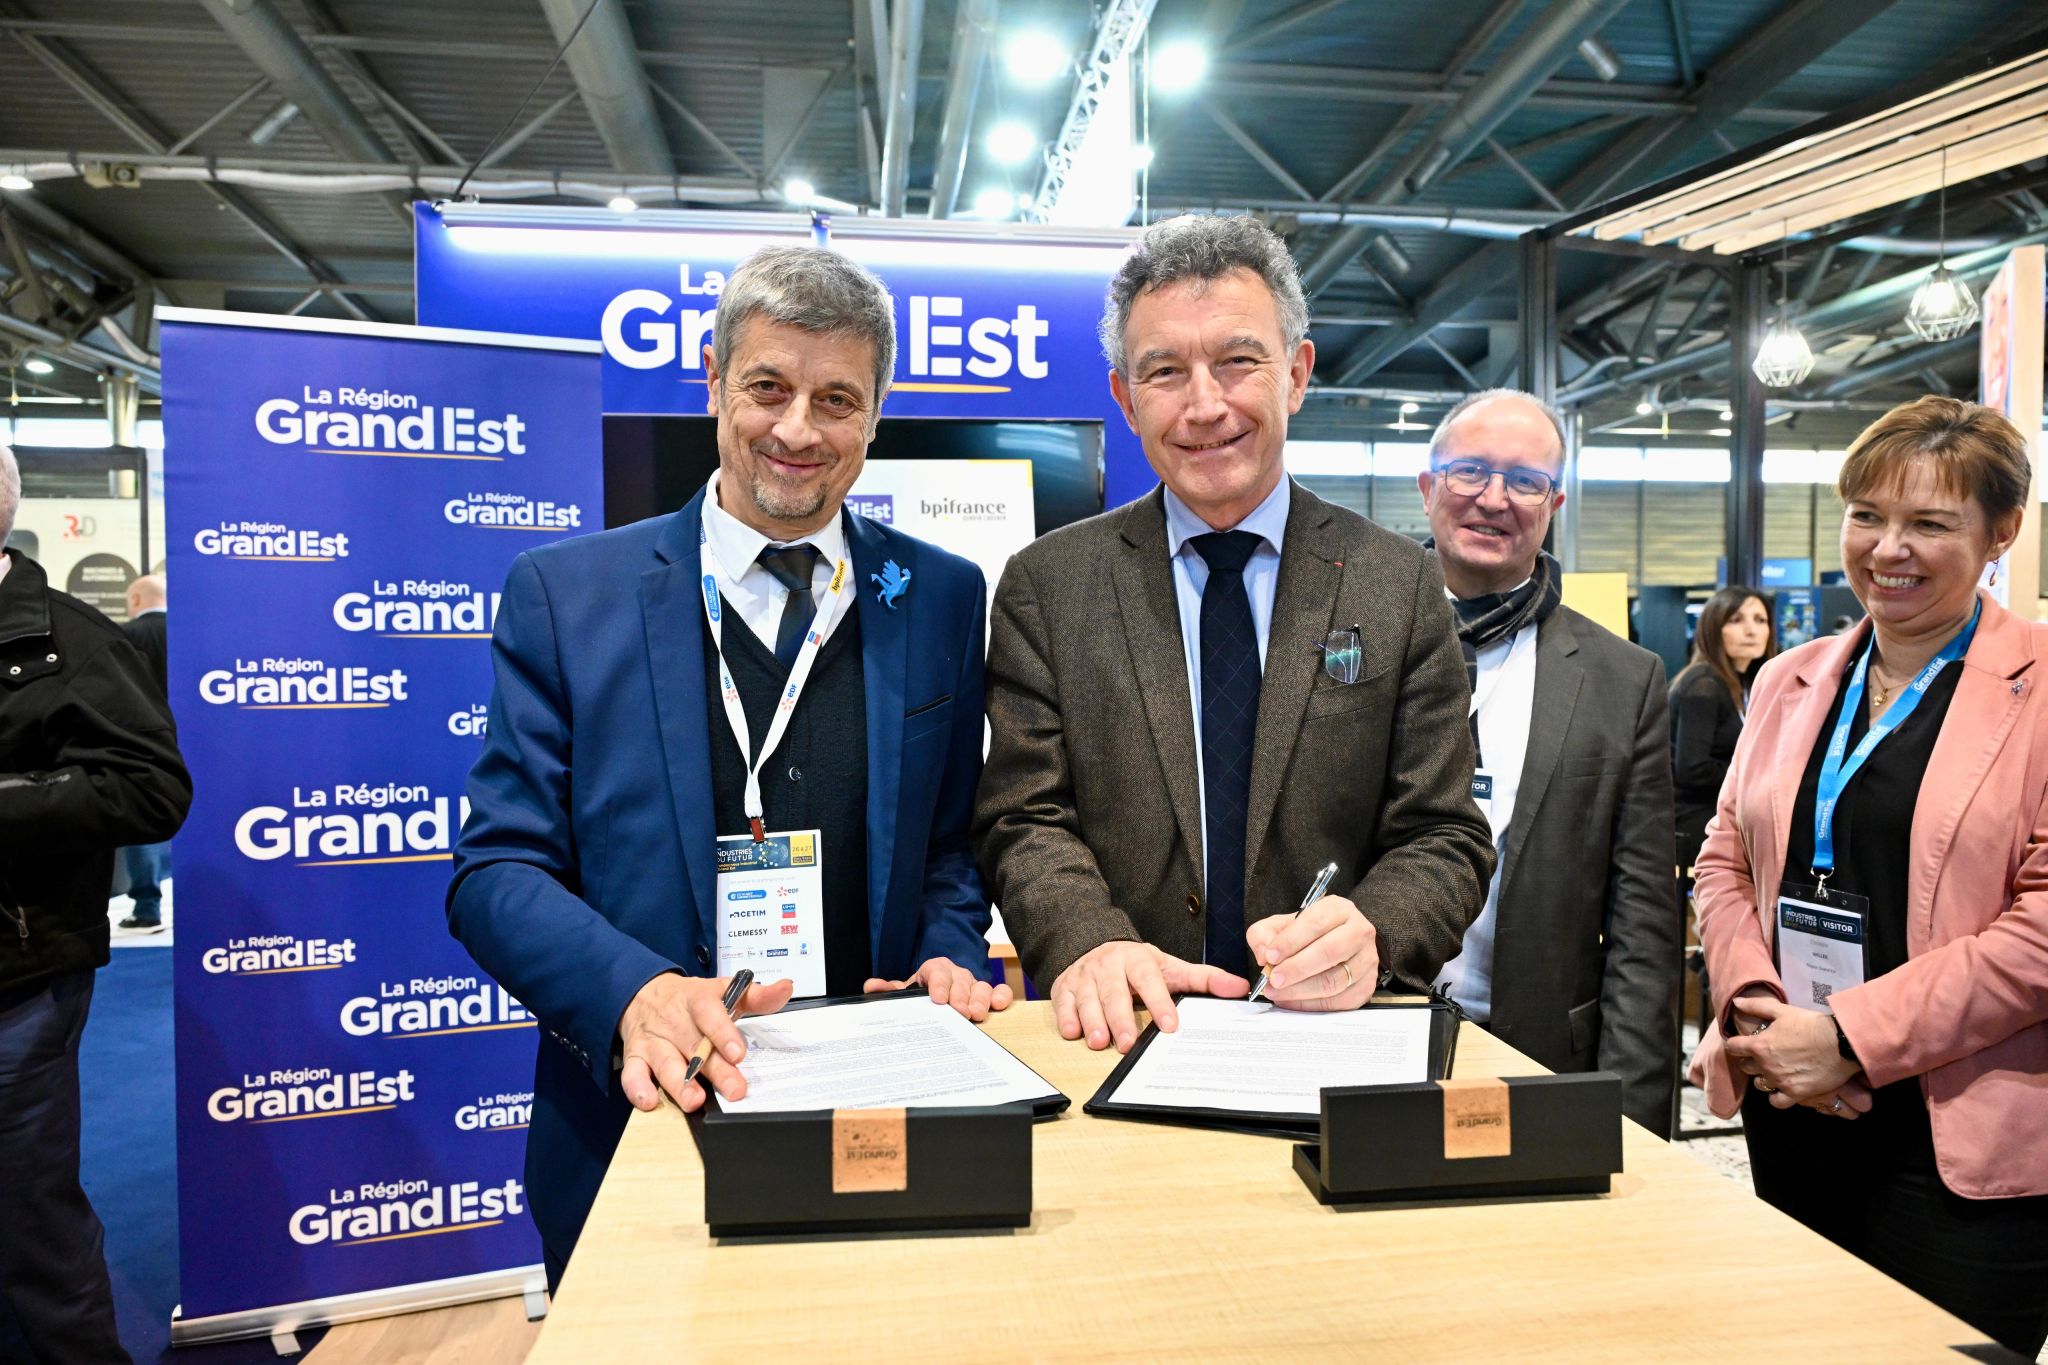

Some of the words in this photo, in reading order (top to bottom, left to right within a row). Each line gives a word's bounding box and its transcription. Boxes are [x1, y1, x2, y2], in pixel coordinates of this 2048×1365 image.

[680, 263, 724, 295] La
[304, 385, 332, 405] La
[339, 388, 417, 411] Région
[468, 493, 483, 503] La
[486, 493, 525, 505] Région
[921, 498, 1006, 518] bpifrance
[221, 522, 237, 532] La
[241, 522, 286, 534] Région
[374, 580, 397, 595] La
[404, 580, 469, 598] Région
[333, 593, 484, 631] Grand
[236, 659, 258, 673] La
[263, 658, 323, 674] Région
[472, 704, 486, 714] La
[295, 786, 326, 807] La
[336, 783, 428, 807] Région
[235, 797, 449, 860] Grand
[717, 848, 752, 857] NDUSTRIES
[740, 910, 766, 918] CETIM
[728, 928, 768, 938] CLEMESSY
[780, 924, 799, 932] SEW
[1822, 920, 1853, 933] VISITOR
[230, 939, 245, 949] La
[249, 936, 293, 948] Région
[382, 983, 404, 997] La
[411, 976, 476, 995] Région
[341, 985, 491, 1035] Grand
[245, 1075, 265, 1087] La
[271, 1068, 330, 1084] Région
[479, 1097, 493, 1107] La
[331, 1189, 354, 1204] La
[361, 1179, 428, 1201] Région
